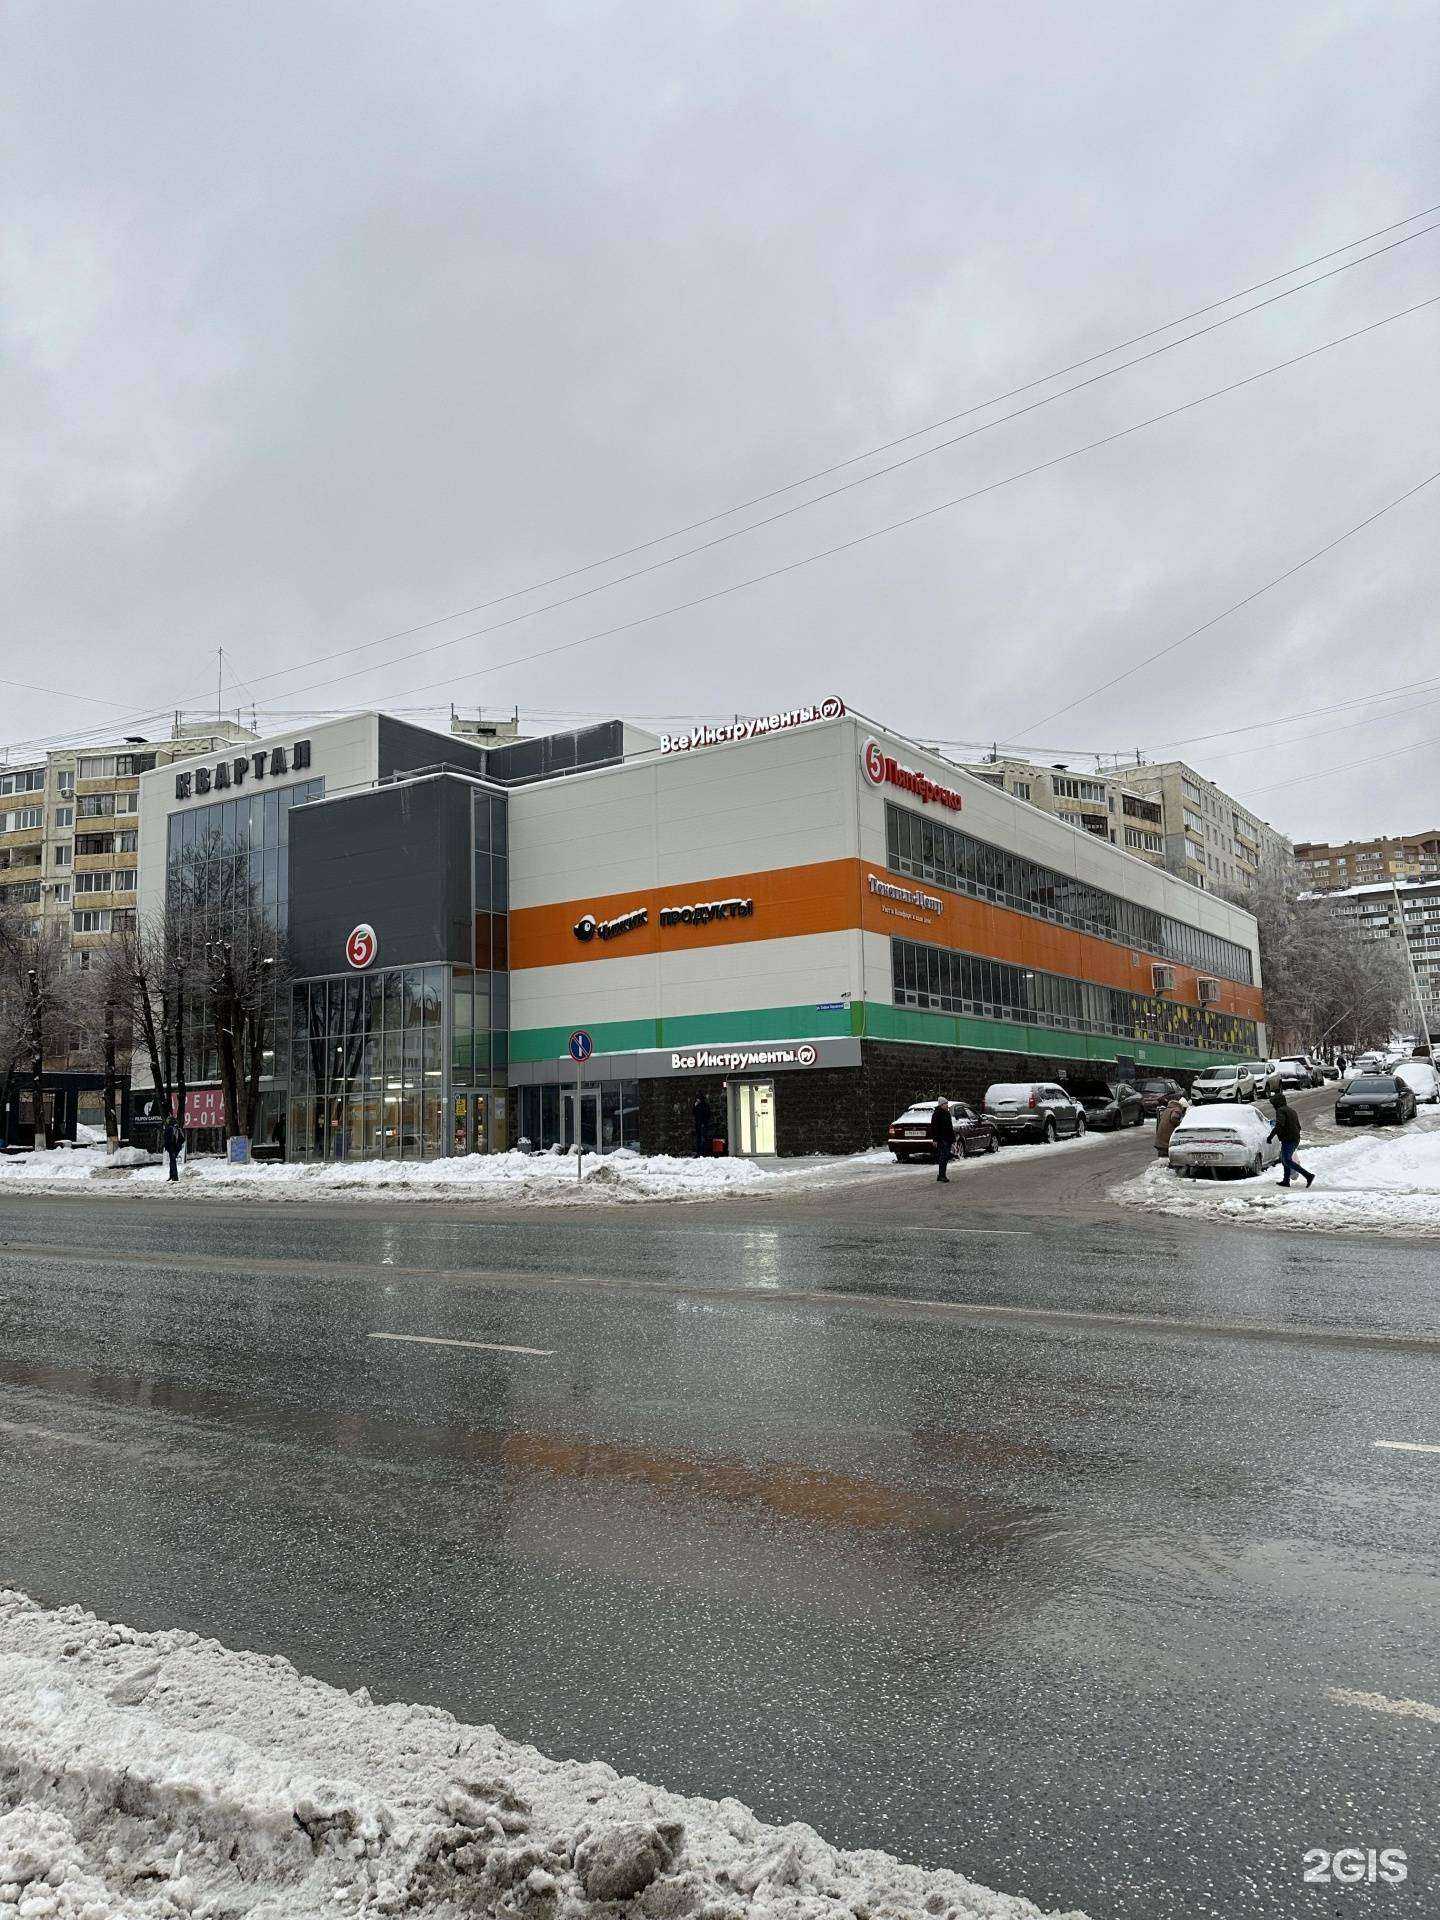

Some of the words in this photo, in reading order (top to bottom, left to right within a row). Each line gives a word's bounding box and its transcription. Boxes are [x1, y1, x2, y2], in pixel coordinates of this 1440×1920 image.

[175, 739, 311, 800] КВАРТАЛ
[885, 756, 962, 811] Пятёрочка
[660, 898, 753, 927] ПРОДУКТЫ
